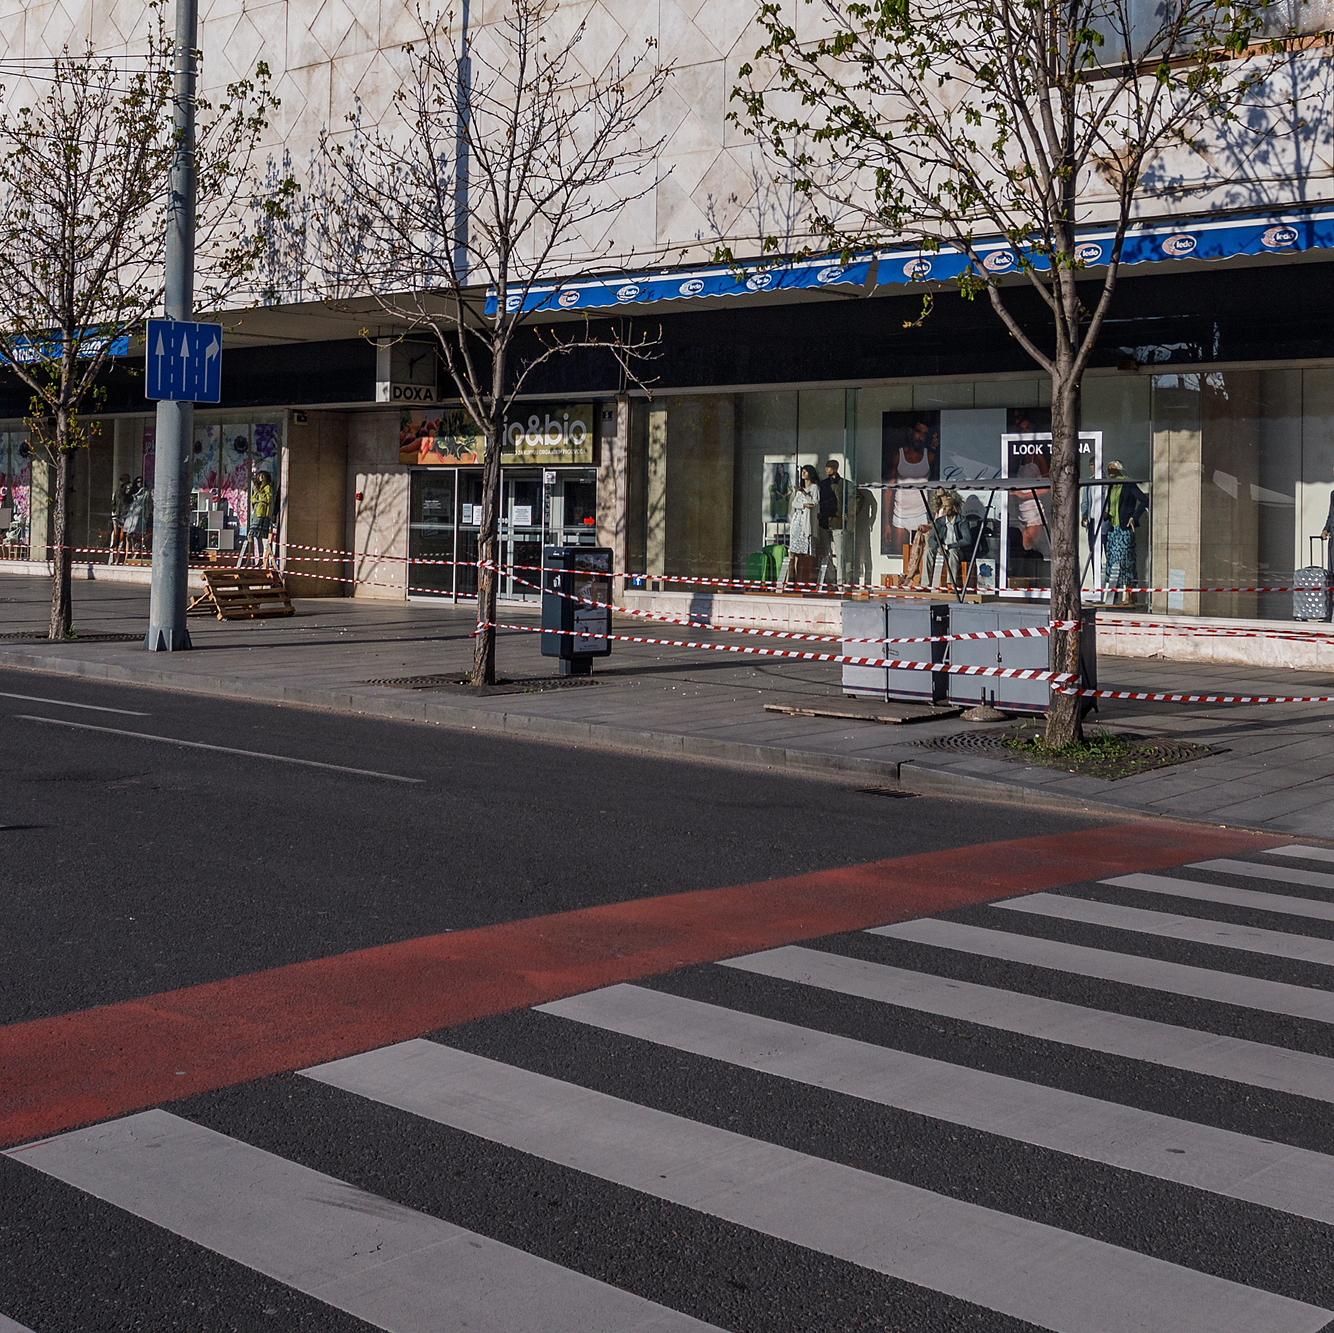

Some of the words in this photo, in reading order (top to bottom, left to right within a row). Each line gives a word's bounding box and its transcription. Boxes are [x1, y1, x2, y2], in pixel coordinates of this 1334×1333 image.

[1276, 232, 1294, 240] ledo
[1176, 240, 1193, 248] ledo
[995, 256, 1011, 264] ledo
[914, 264, 928, 272] ledo
[393, 386, 434, 402] DOXA
[485, 412, 587, 447] io&bio
[1012, 443, 1043, 455] LOOK
[1047, 442, 1091, 454] TNA
